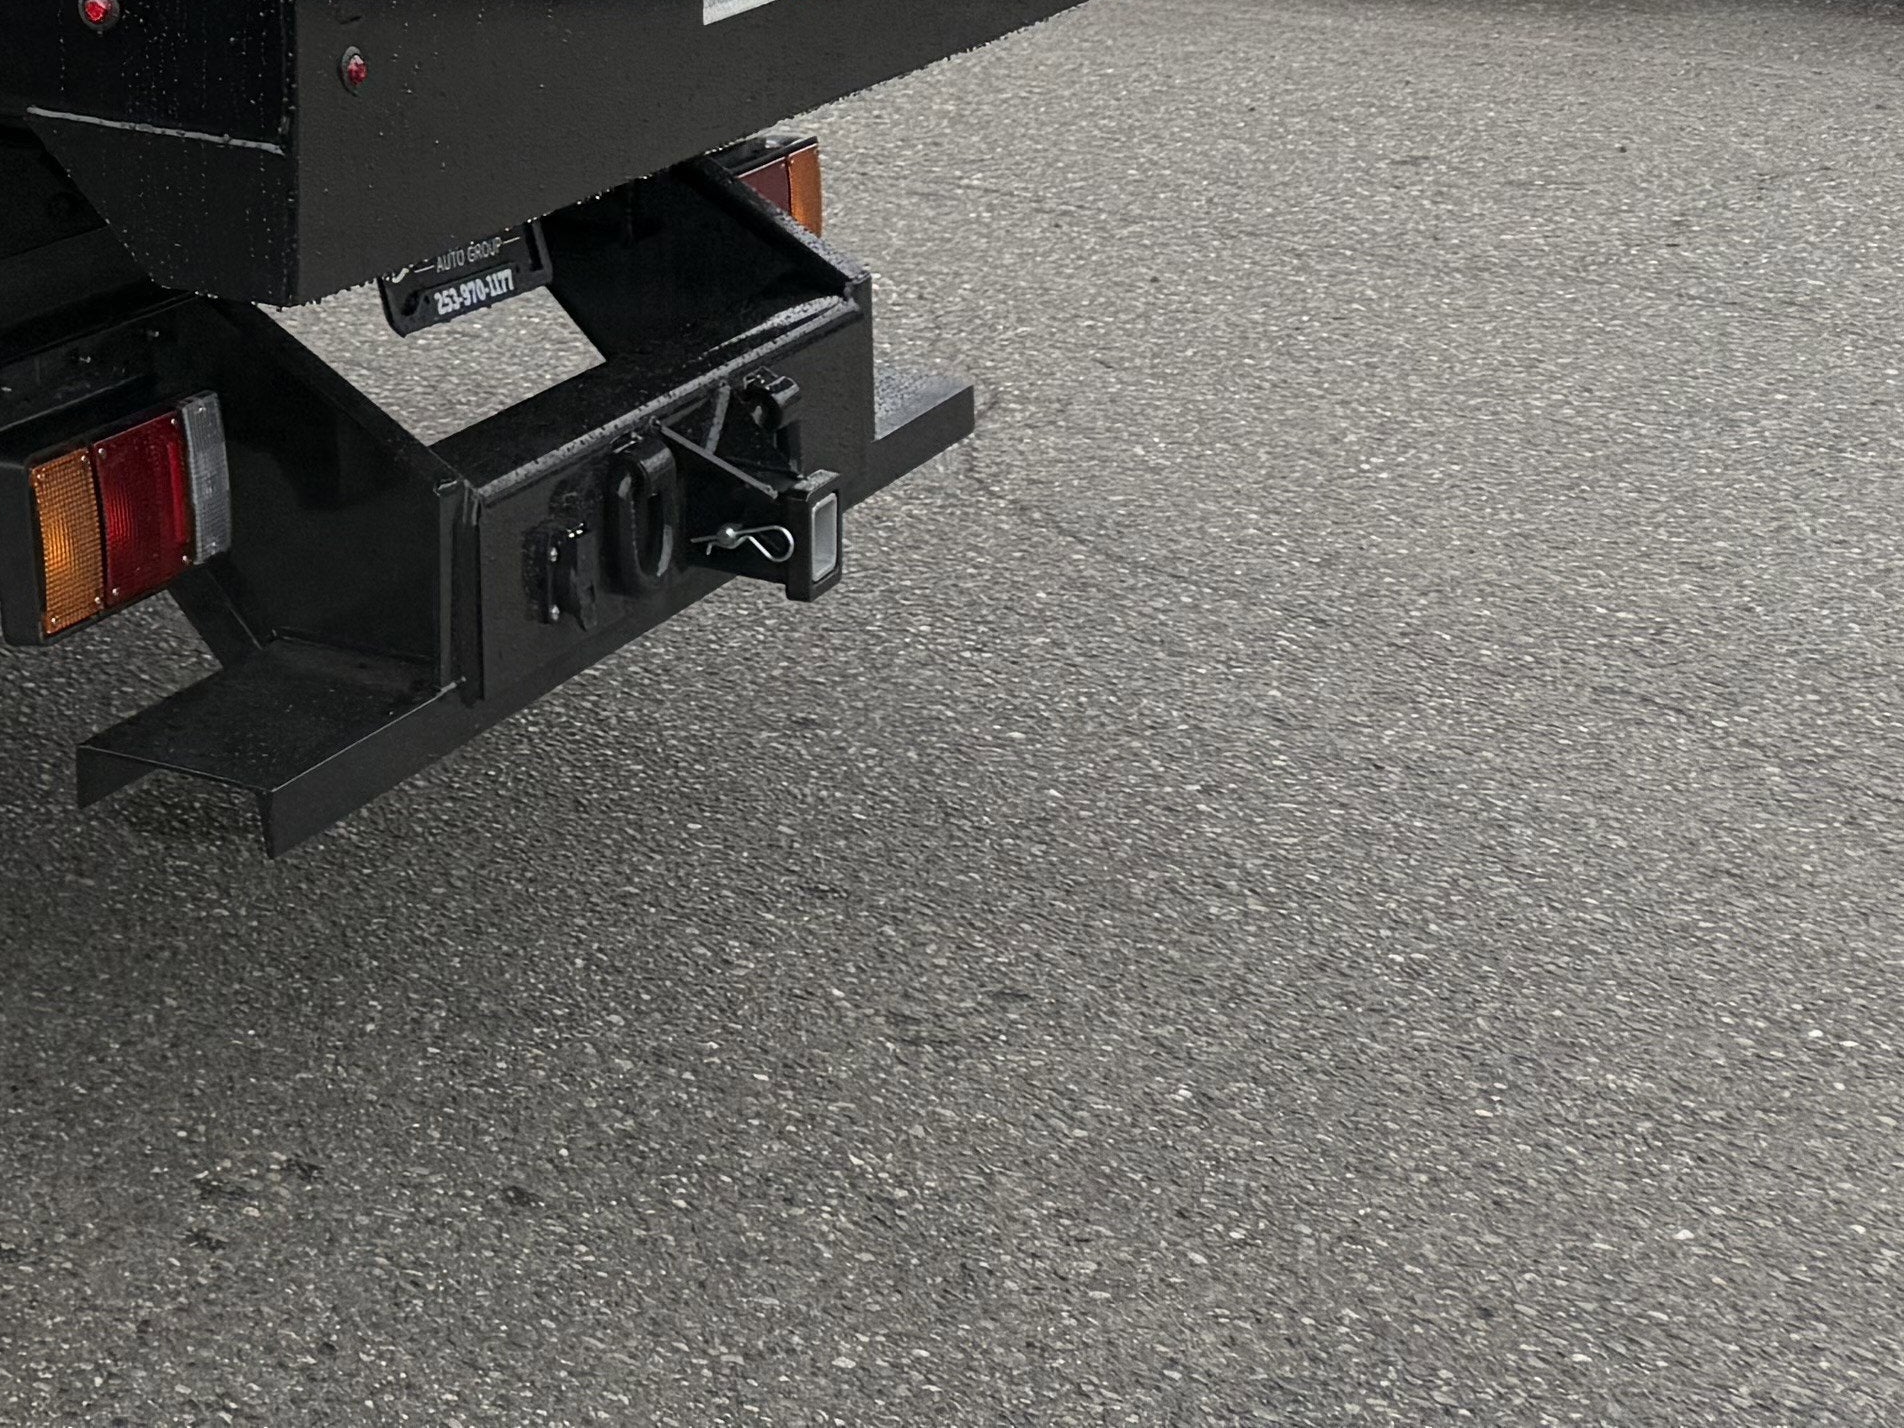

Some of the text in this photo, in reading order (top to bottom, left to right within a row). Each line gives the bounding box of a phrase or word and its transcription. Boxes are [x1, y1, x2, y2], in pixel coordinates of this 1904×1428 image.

[435, 237, 503, 274] AUTO GROUP
[433, 268, 515, 316] 253-970-1177
